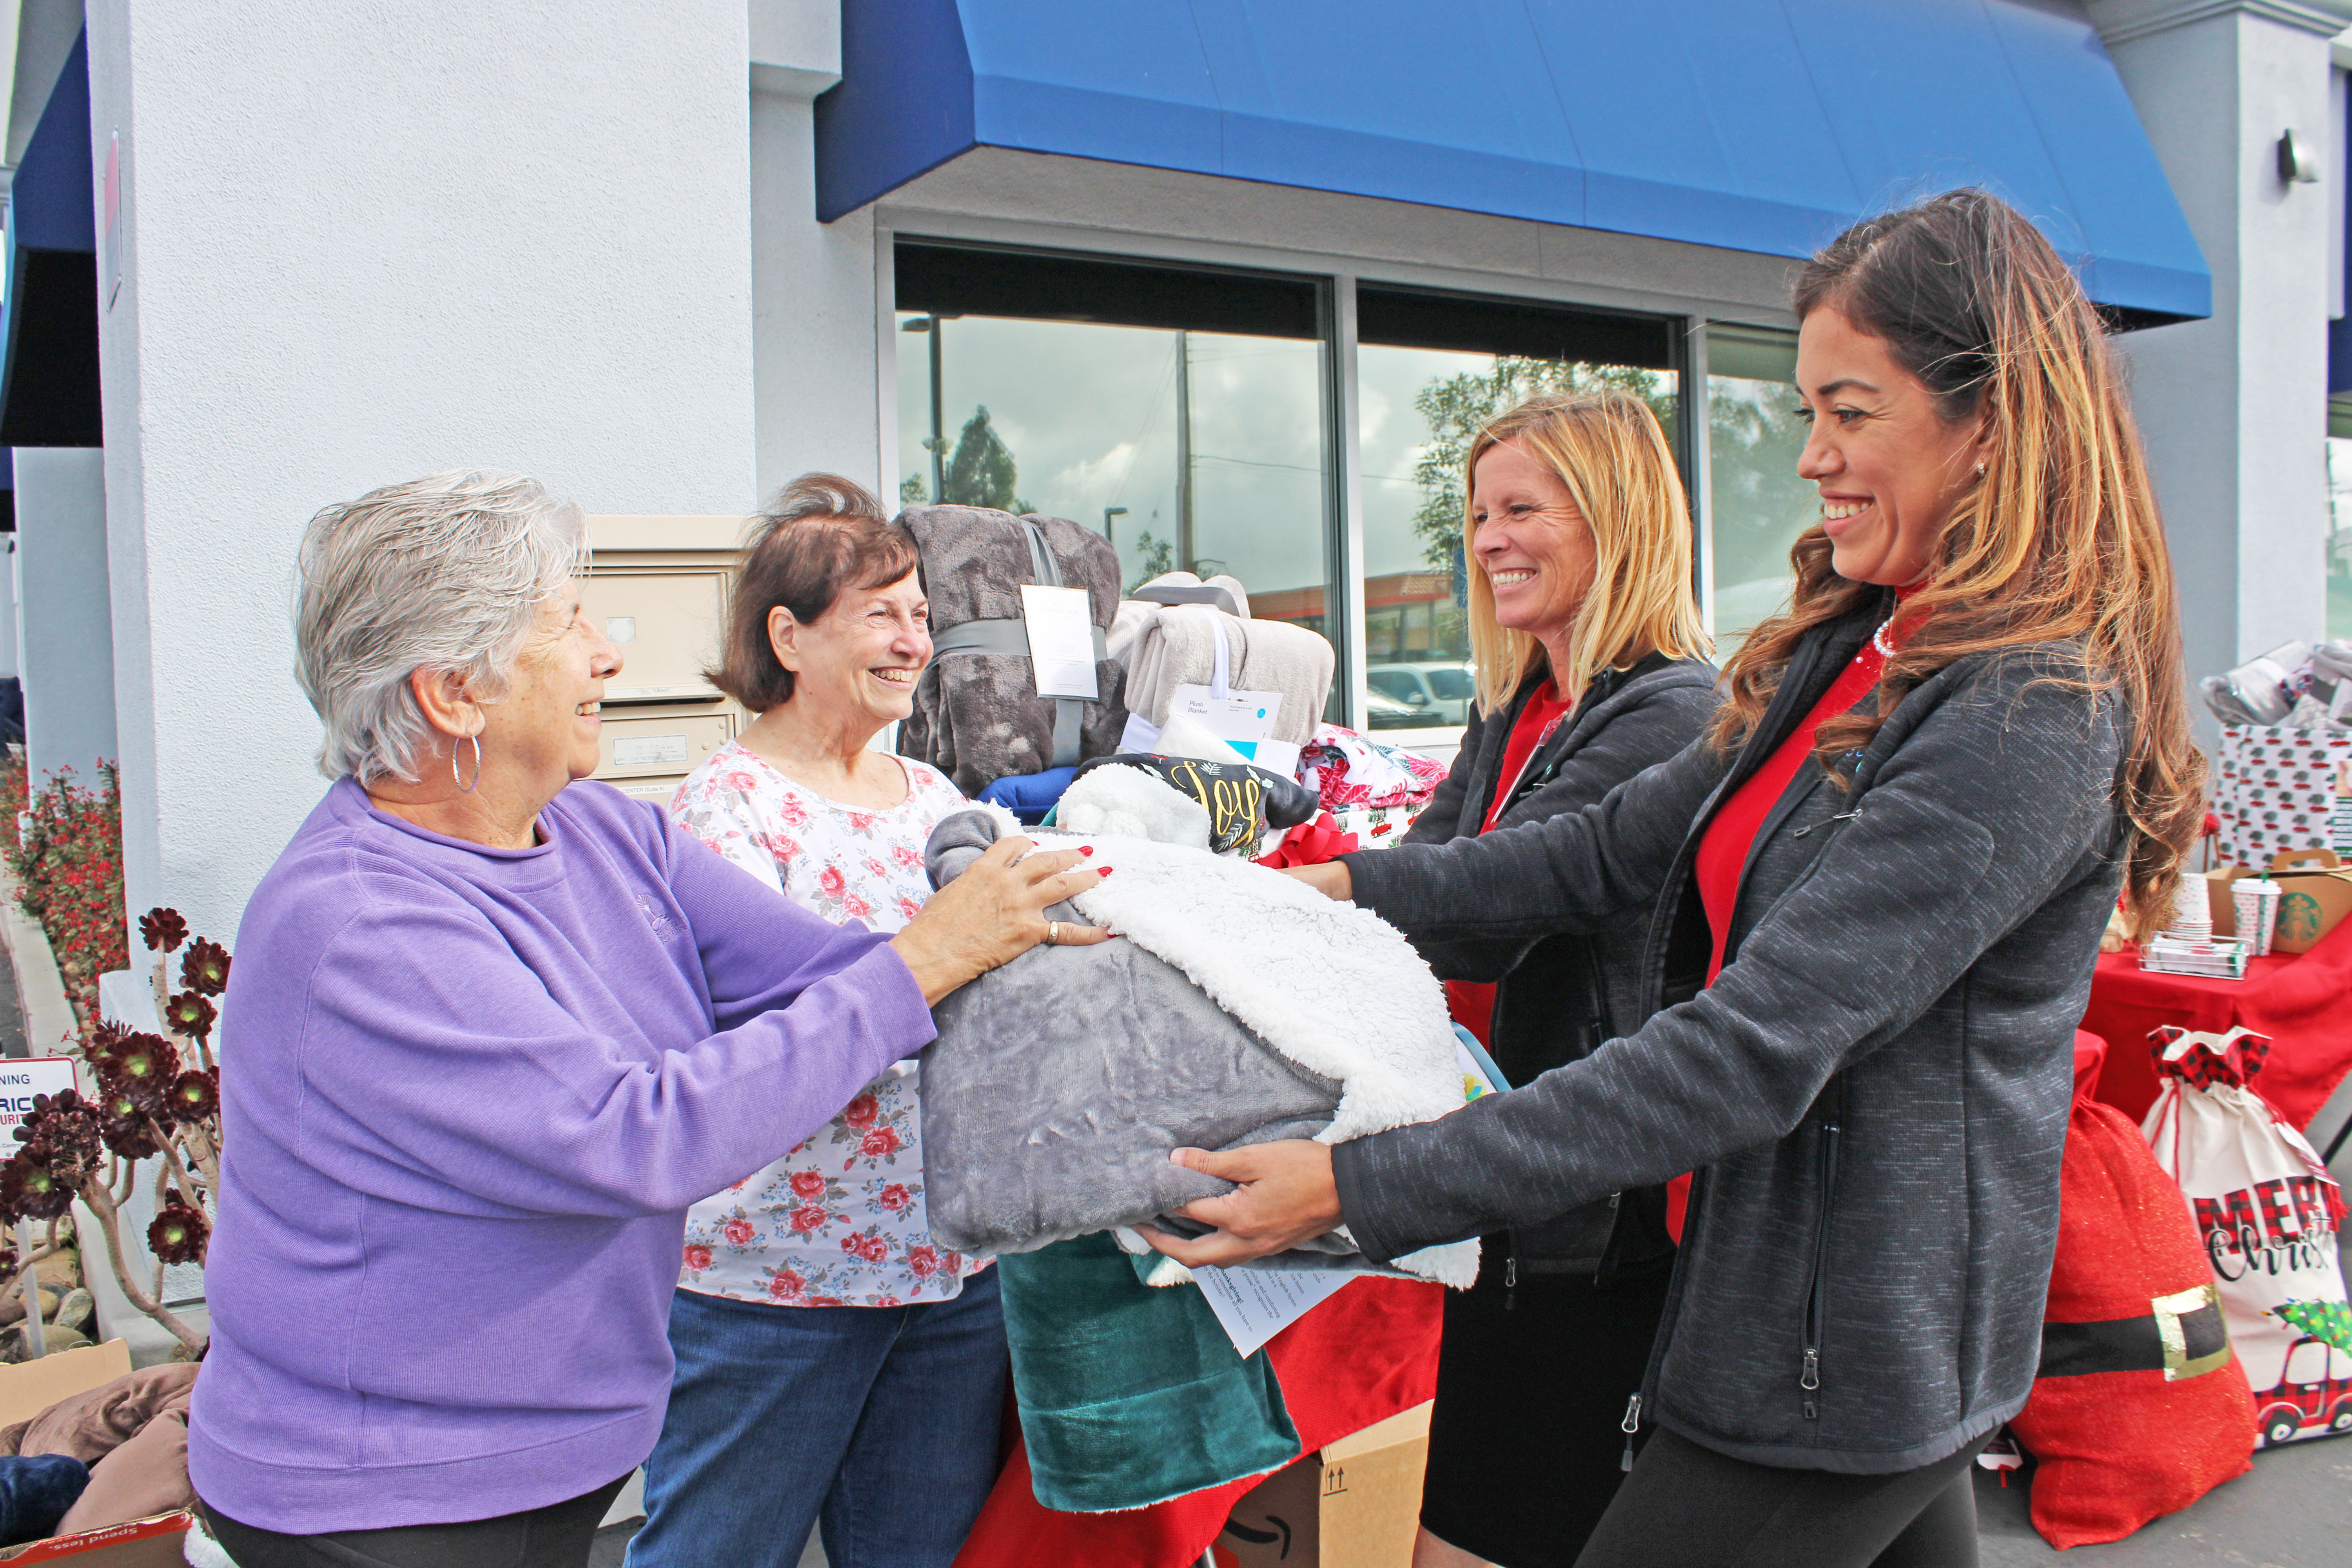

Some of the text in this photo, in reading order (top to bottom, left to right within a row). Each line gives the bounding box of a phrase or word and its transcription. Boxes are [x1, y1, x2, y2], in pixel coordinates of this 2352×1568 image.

[1171, 760, 1260, 849] Joy
[0, 1074, 30, 1085] NING
[0, 1098, 32, 1112] RIC
[0, 1114, 27, 1125] URI
[1265, 1270, 1274, 1279] and
[1212, 1279, 1225, 1298] holiday!
[1277, 1276, 1289, 1294] English
[1287, 1292, 1297, 1307] hymn
[1294, 1280, 1305, 1294] hymn
[1218, 1278, 1233, 1300] remember
[1241, 1314, 1250, 1327] have
[1254, 1288, 1269, 1311] recognizes
[1259, 1285, 1267, 1294] and
[1264, 1294, 1281, 1319] comforting
[89, 1527, 138, 1544] Spend
[49, 1540, 83, 1551] less.
